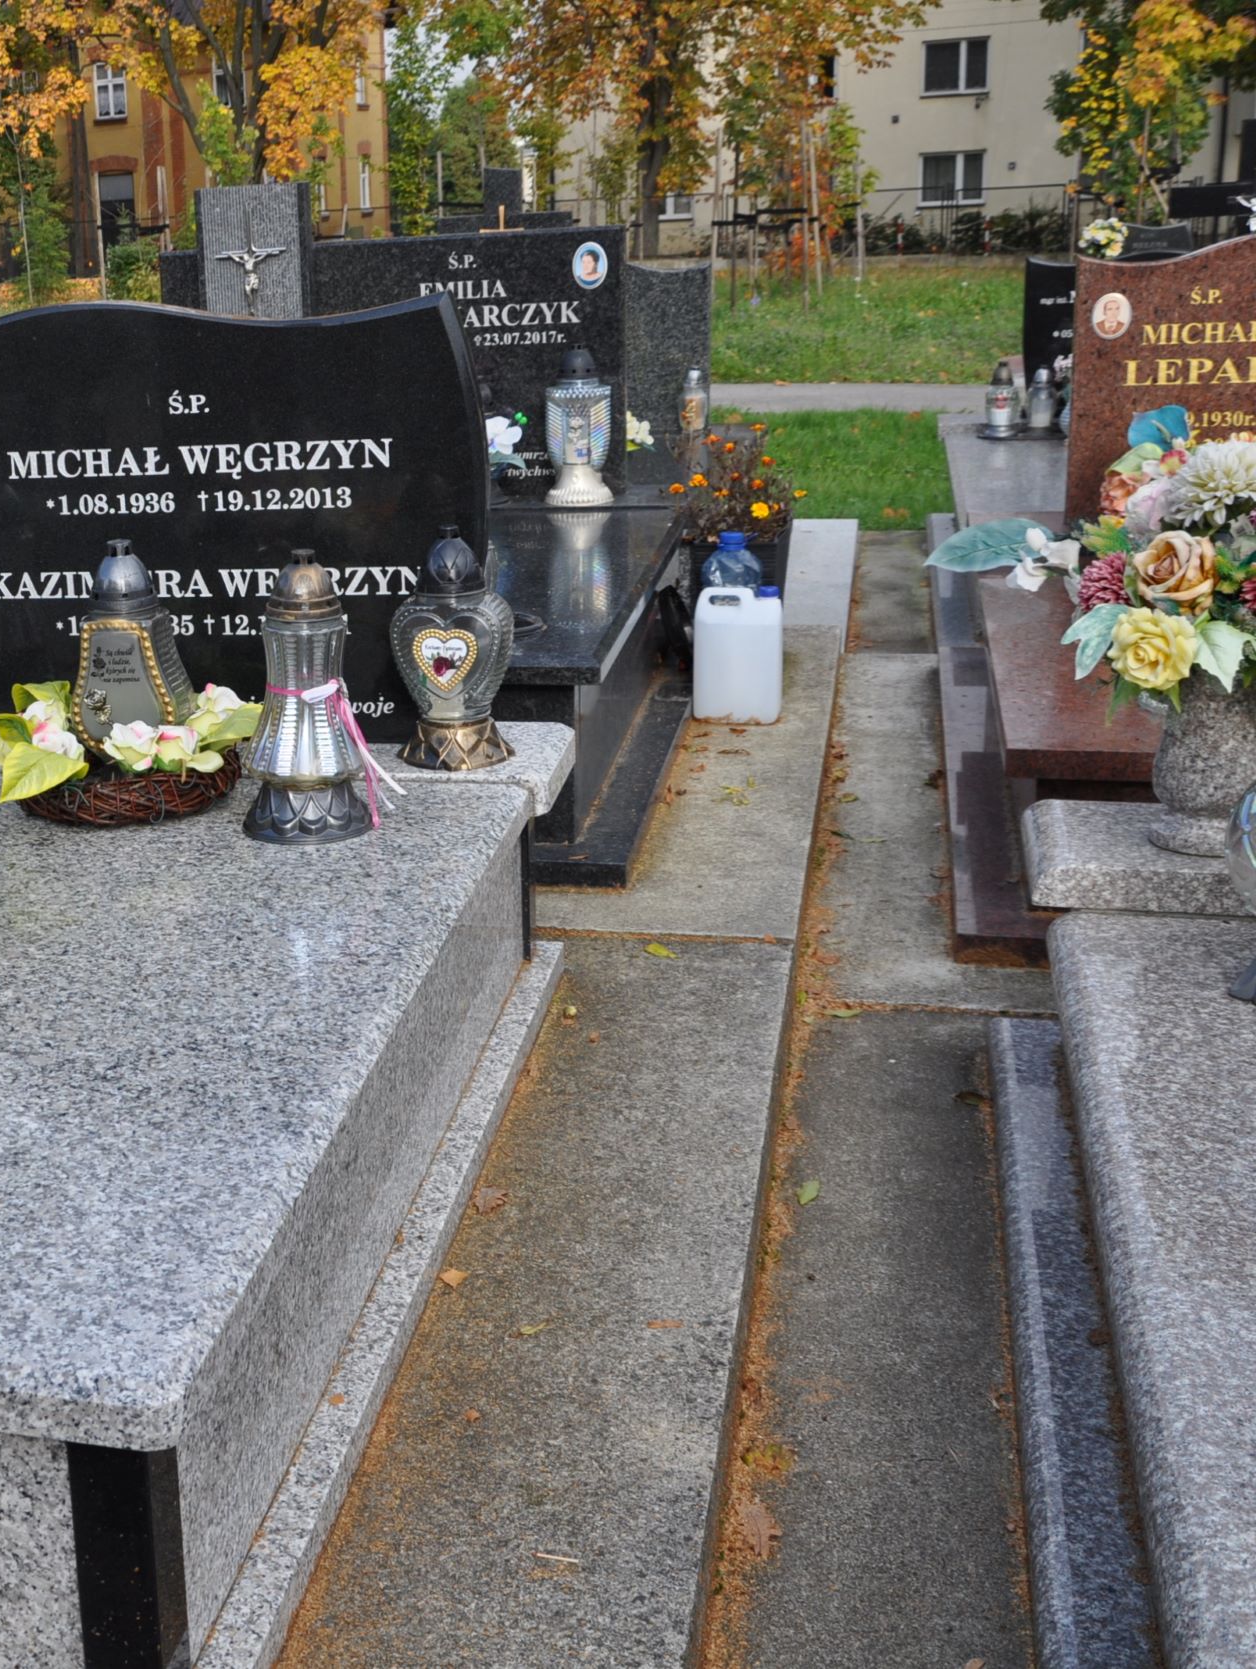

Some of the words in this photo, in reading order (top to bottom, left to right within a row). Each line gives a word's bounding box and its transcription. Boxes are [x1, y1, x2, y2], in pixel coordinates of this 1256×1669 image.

[448, 251, 477, 270] Ś.P.
[1190, 286, 1223, 305] Ś.P.
[463, 301, 581, 328] ARCZYK
[168, 390, 210, 415] Ś.P.
[7, 446, 170, 480] MICHAŁ
[178, 437, 393, 480] WĘGRZYN
[351, 697, 395, 718] woje
